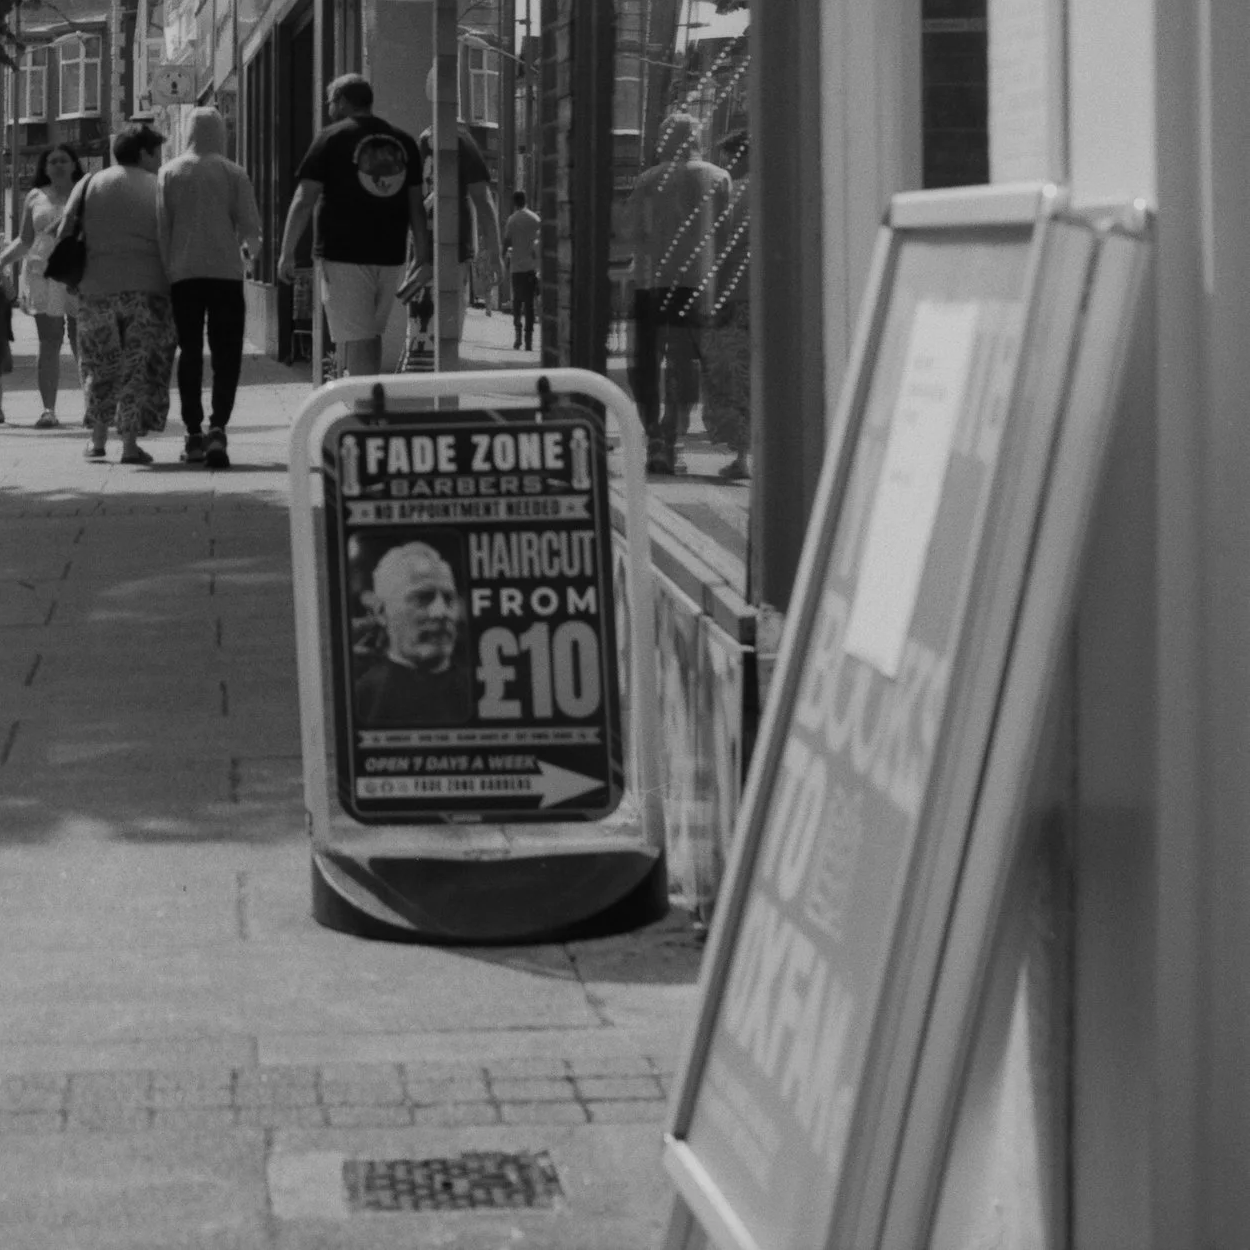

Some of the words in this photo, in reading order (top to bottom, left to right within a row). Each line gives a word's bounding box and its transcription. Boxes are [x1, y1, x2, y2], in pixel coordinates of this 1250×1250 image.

[365, 434, 457, 474] FADE
[470, 431, 564, 471] ZONE
[389, 475, 543, 497] BARBERS
[399, 501, 500, 519] APPOINTMENT
[468, 530, 595, 579] HAIRCUT
[471, 586, 597, 617] FROM
[476, 620, 600, 719] £10
[364, 755, 410, 772] OPEN
[425, 754, 469, 771] DAYS
[470, 755, 484, 770] A
[487, 754, 537, 770] WEEK
